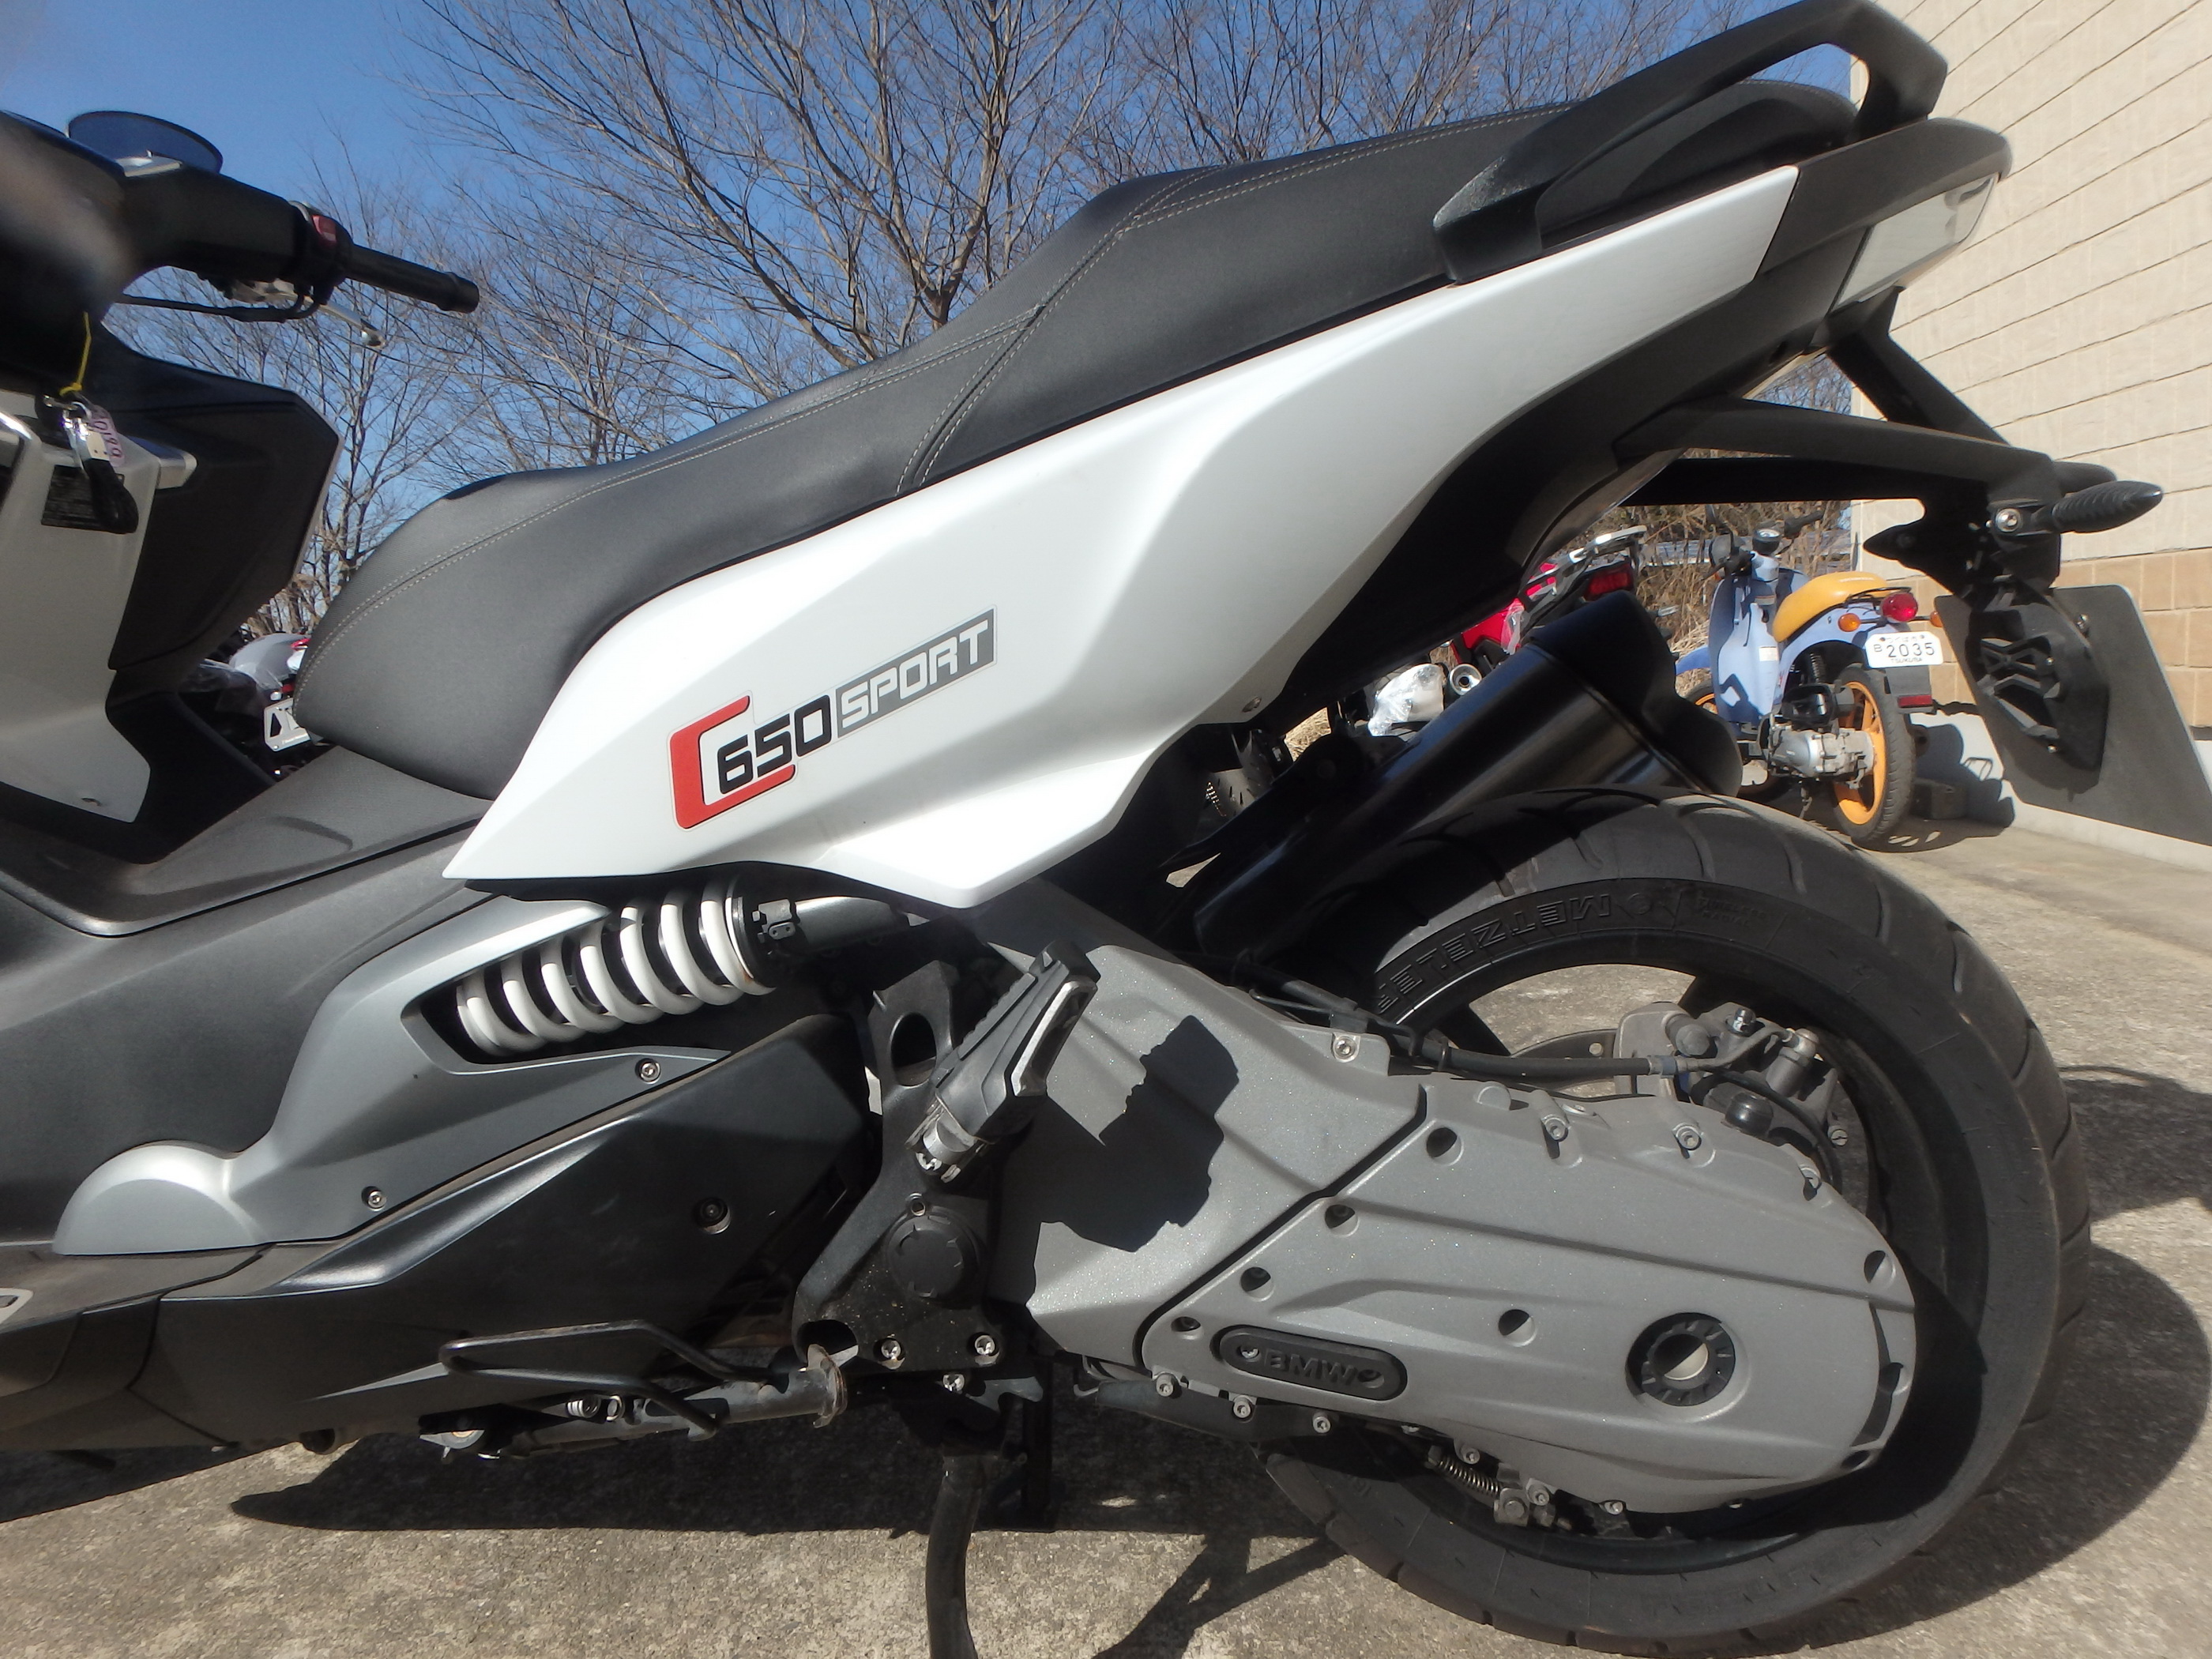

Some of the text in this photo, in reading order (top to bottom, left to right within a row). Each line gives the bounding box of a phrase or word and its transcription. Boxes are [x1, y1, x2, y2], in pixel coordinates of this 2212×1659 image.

[1874, 642, 1935, 657] B 2035
[1885, 635, 1917, 644] つくば市
[841, 619, 988, 728] SPORT
[1266, 1349, 1360, 1383] BMW
